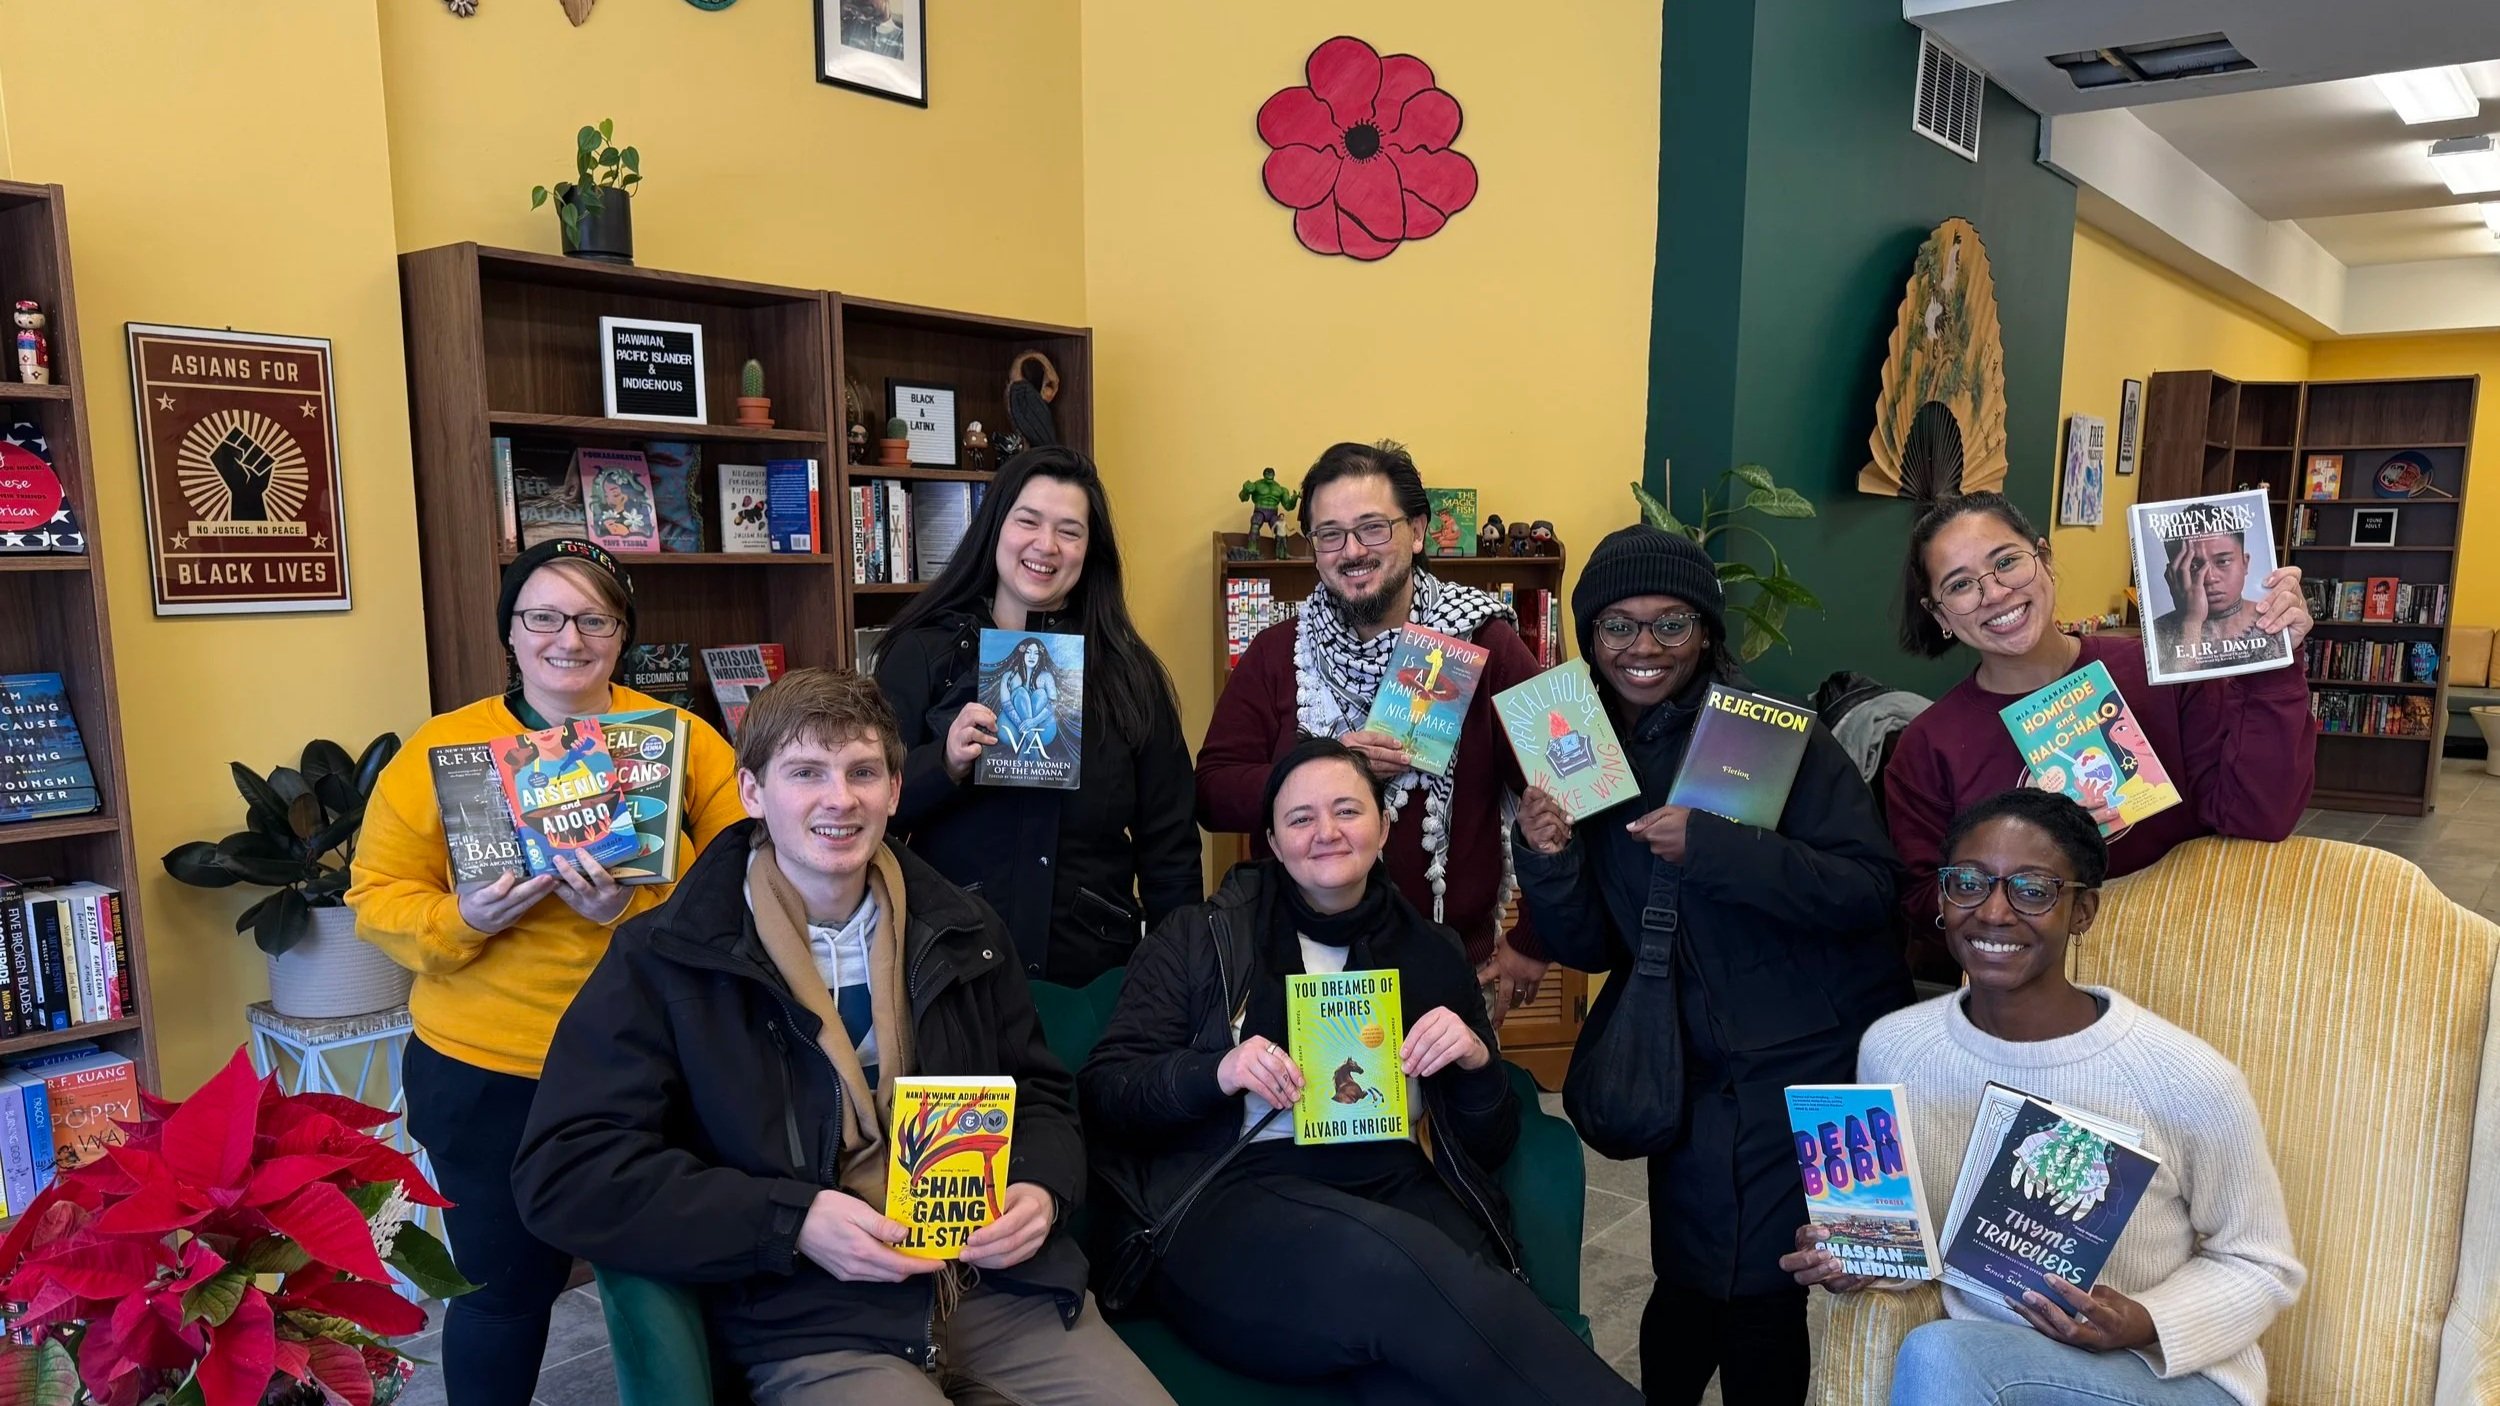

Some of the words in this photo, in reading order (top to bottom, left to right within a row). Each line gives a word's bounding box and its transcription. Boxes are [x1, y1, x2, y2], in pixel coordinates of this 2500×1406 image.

[618, 332, 665, 348] HAWAIIAN,
[171, 353, 250, 379] ASIANS
[261, 361, 299, 382] FOR
[616, 350, 649, 362] PACIFIC
[651, 352, 692, 365] ISLANDER
[648, 364, 656, 375] &
[622, 377, 683, 392] INDIGENOUS
[910, 394, 935, 404] BLACK
[919, 408, 926, 418] &
[910, 420, 936, 432] LATINX
[2089, 425, 2104, 448] FREE
[1442, 497, 1475, 507] MAGIC
[1457, 491, 1475, 500] THE
[1456, 506, 1475, 514] FISH
[2148, 509, 2206, 528] BROWN
[2211, 504, 2256, 522] SKIN,
[196, 526, 208, 534] NO
[213, 526, 254, 534] JUSTICE.
[257, 526, 269, 534] NO
[272, 526, 304, 534] PEACE.
[2153, 523, 2200, 540] WHITE
[2204, 516, 2254, 534] MINDS
[178, 562, 254, 585] BLACK
[264, 562, 327, 583] LIVES
[1404, 630, 1444, 650] EVERY
[1446, 644, 1480, 664] DROP
[2175, 642, 2218, 659] E.J.R.
[2222, 637, 2267, 653] DAVID
[708, 650, 760, 666] PRISON
[1402, 654, 1416, 668] IS
[636, 672, 674, 684] BECOMING
[676, 672, 688, 682] KIN
[712, 666, 765, 680] WRITINGS
[1414, 669, 1424, 682] A
[1506, 684, 1550, 756] RENTAL
[1548, 672, 1600, 726] HOUSE
[1708, 690, 1808, 733] REJECTION
[2021, 680, 2095, 736] HOMICIDE
[1384, 703, 1456, 735] NIGHTMARE
[2055, 712, 2076, 730] and
[604, 731, 638, 749] EAL
[2028, 702, 2118, 766] HALO-HALO
[437, 754, 468, 766] R.F.
[470, 752, 491, 763] KU
[986, 758, 1022, 768] STORIES
[1024, 760, 1035, 768] BY
[1036, 760, 1071, 770] WOMEN
[994, 766, 1006, 774] OF
[1011, 767, 1028, 775] THE
[1030, 768, 1063, 776] MOANA
[1534, 768, 1586, 812] WEKE
[1589, 743, 1626, 800] WANG
[1722, 765, 1751, 780] Fiction
[10, 790, 68, 804] MAYER
[522, 772, 610, 807] ARSENIC
[560, 798, 582, 810] and
[542, 802, 610, 834] ADOBO
[111, 896, 120, 914] YOUR
[8, 908, 22, 930] FIVE
[112, 914, 122, 935] HOUSE
[11, 930, 27, 974] BROKEN
[86, 906, 98, 946] BESTIARY
[96, 978, 104, 998] CHANG
[115, 936, 124, 950] WILL
[117, 950, 126, 962] PAY
[18, 976, 33, 1014] BLADES
[1294, 982, 1317, 998] YOU
[1322, 977, 1375, 998] DREAMED
[1380, 977, 1393, 993] OF
[1320, 1000, 1371, 1018] EMPIRES
[48, 1076, 72, 1089] R.F.
[76, 1066, 126, 1084] KUANG
[906, 1091, 922, 1099] NANA
[925, 1092, 956, 1100] KWAME
[33, 1097, 44, 1128] DRAGON
[51, 1099, 132, 1132] POPPY
[1304, 1119, 1348, 1139] ÁLVARO
[1352, 1116, 1402, 1136] ENRIGUE
[1794, 1106, 1896, 1164] DEAR
[78, 1129, 129, 1152] WA
[1802, 1140, 1904, 1196] BORN
[911, 1175, 986, 1199] CHAIN
[913, 1200, 986, 1224] GANG
[893, 1226, 983, 1248] LL-STA
[1841, 1259, 1932, 1280] INEDDINE
[2006, 1275, 2032, 1292] Sulaim
